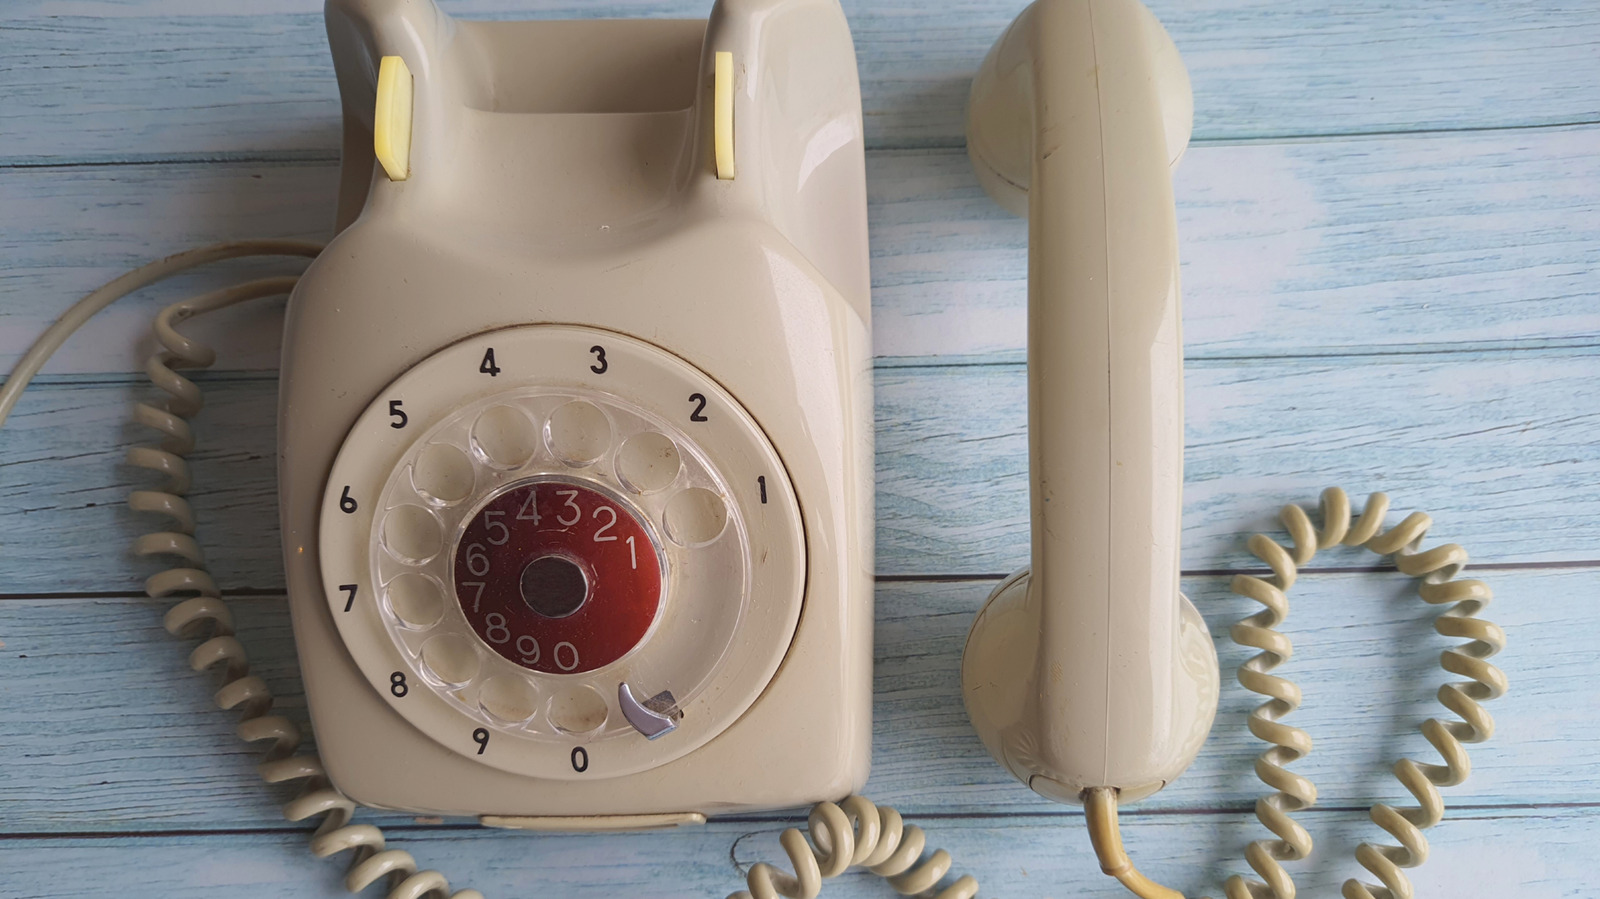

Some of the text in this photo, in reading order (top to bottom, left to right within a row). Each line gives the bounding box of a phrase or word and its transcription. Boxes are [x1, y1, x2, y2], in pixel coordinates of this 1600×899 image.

[480, 348, 500, 377] 4
[590, 346, 607, 374] 3
[389, 400, 408, 429] 5
[689, 393, 708, 422] 2
[340, 486, 357, 514] 6
[758, 476, 767, 504] 1
[516, 491, 542, 525] 4
[556, 491, 581, 526] 3
[485, 512, 509, 545] 5
[593, 506, 617, 542] 2
[467, 544, 489, 576] 6
[626, 536, 636, 569] 1
[339, 584, 358, 612] 7
[463, 582, 485, 612] 7
[486, 613, 510, 643] 8
[517, 636, 540, 663] 9
[554, 642, 579, 670] 0
[390, 671, 408, 697] 8
[473, 728, 489, 754] 9
[571, 747, 588, 772] 0
